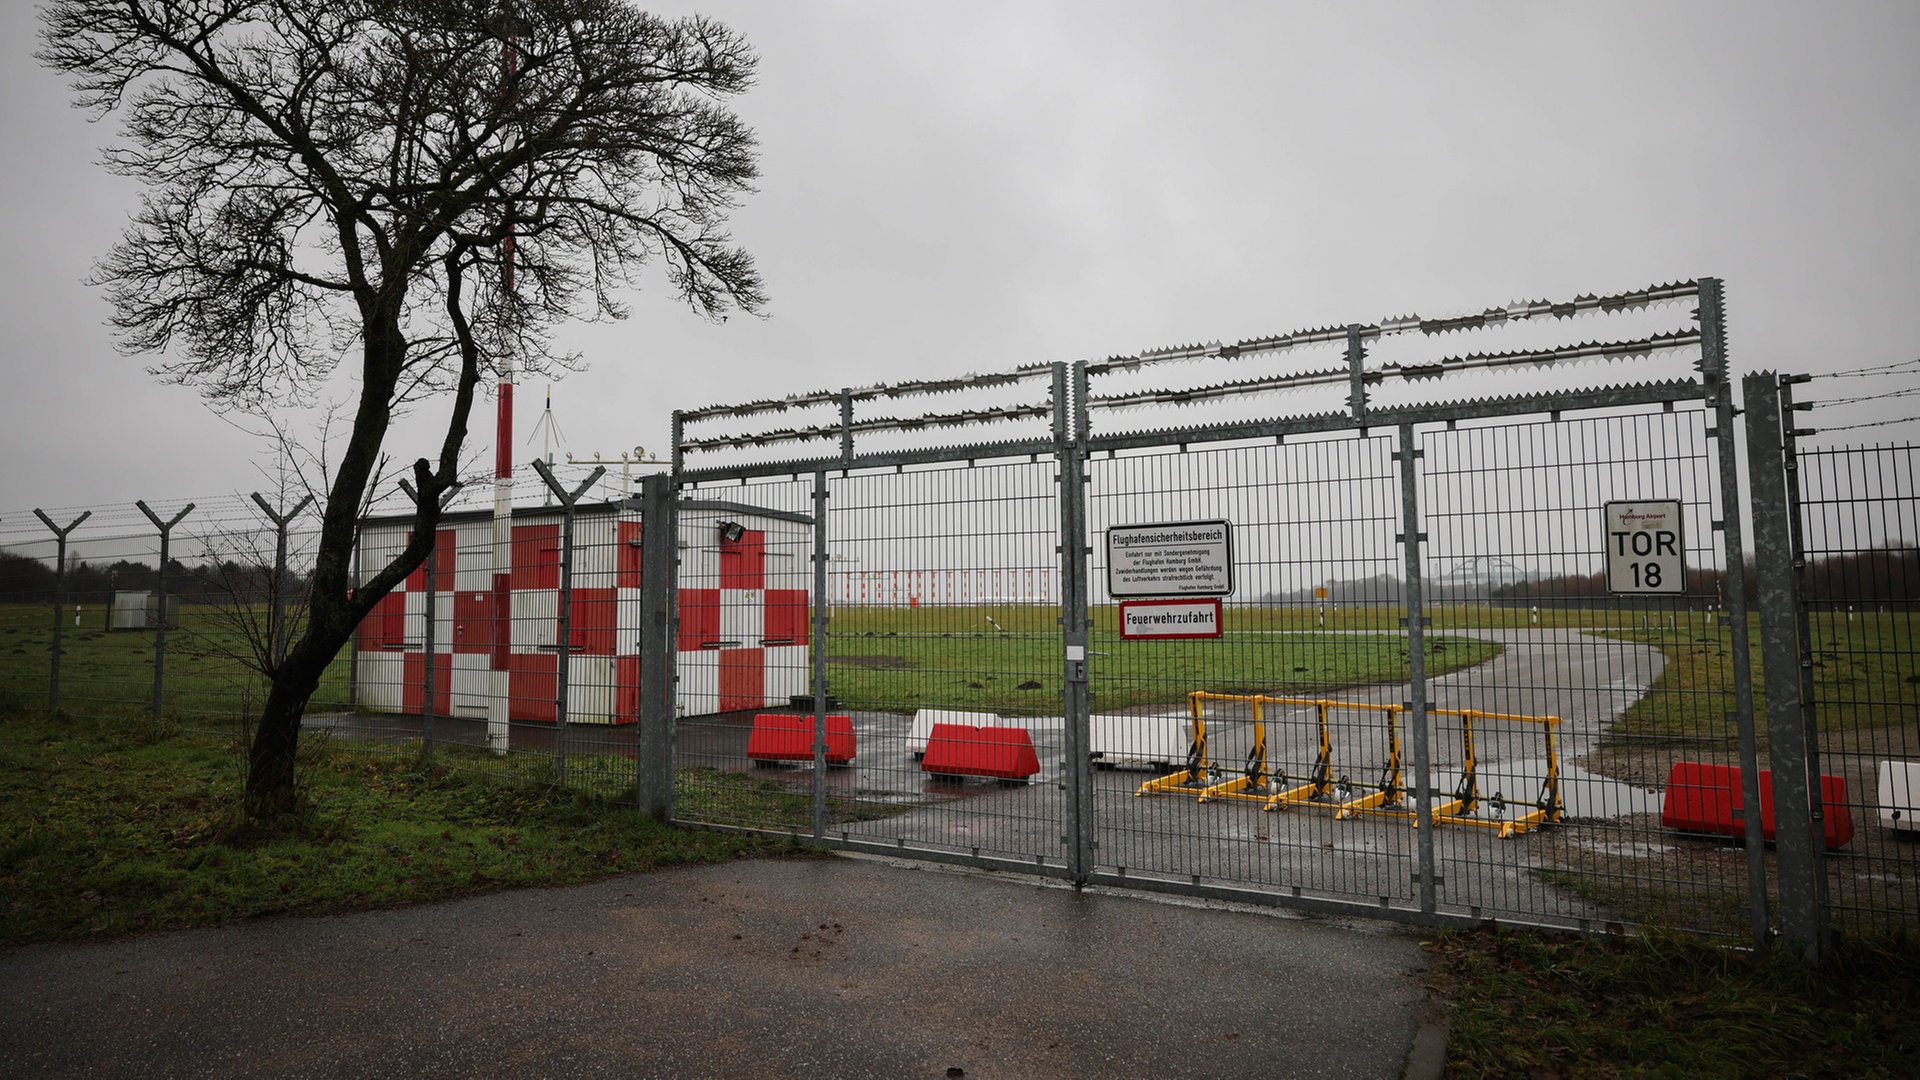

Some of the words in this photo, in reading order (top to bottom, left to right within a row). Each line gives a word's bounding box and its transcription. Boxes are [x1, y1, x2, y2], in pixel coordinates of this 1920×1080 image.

[1113, 530, 1222, 546] Flughafensicherheitsbereich
[1611, 531, 1677, 556] TOR
[1630, 562, 1662, 588] 18
[1126, 611, 1214, 625] Feuerwehrzufahrt
